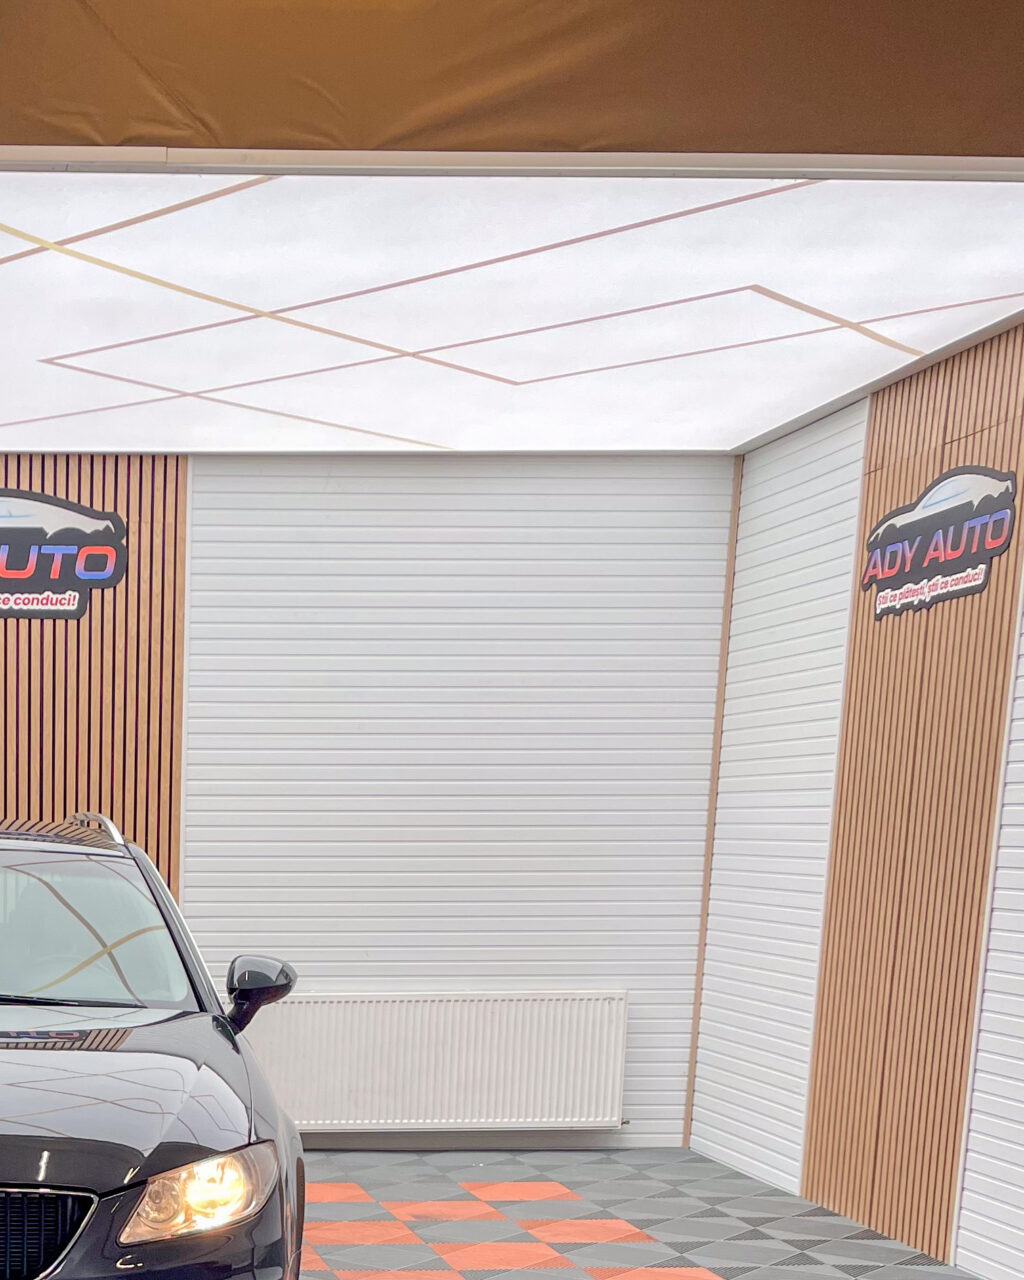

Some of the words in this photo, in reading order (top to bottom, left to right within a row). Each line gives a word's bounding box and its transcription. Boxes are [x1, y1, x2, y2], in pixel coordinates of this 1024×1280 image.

[863, 535, 922, 584] ADY
[923, 509, 1010, 567] AUTO
[13, 593, 76, 606] conduci!
[889, 593, 897, 604] ce
[940, 580, 948, 589] ce
